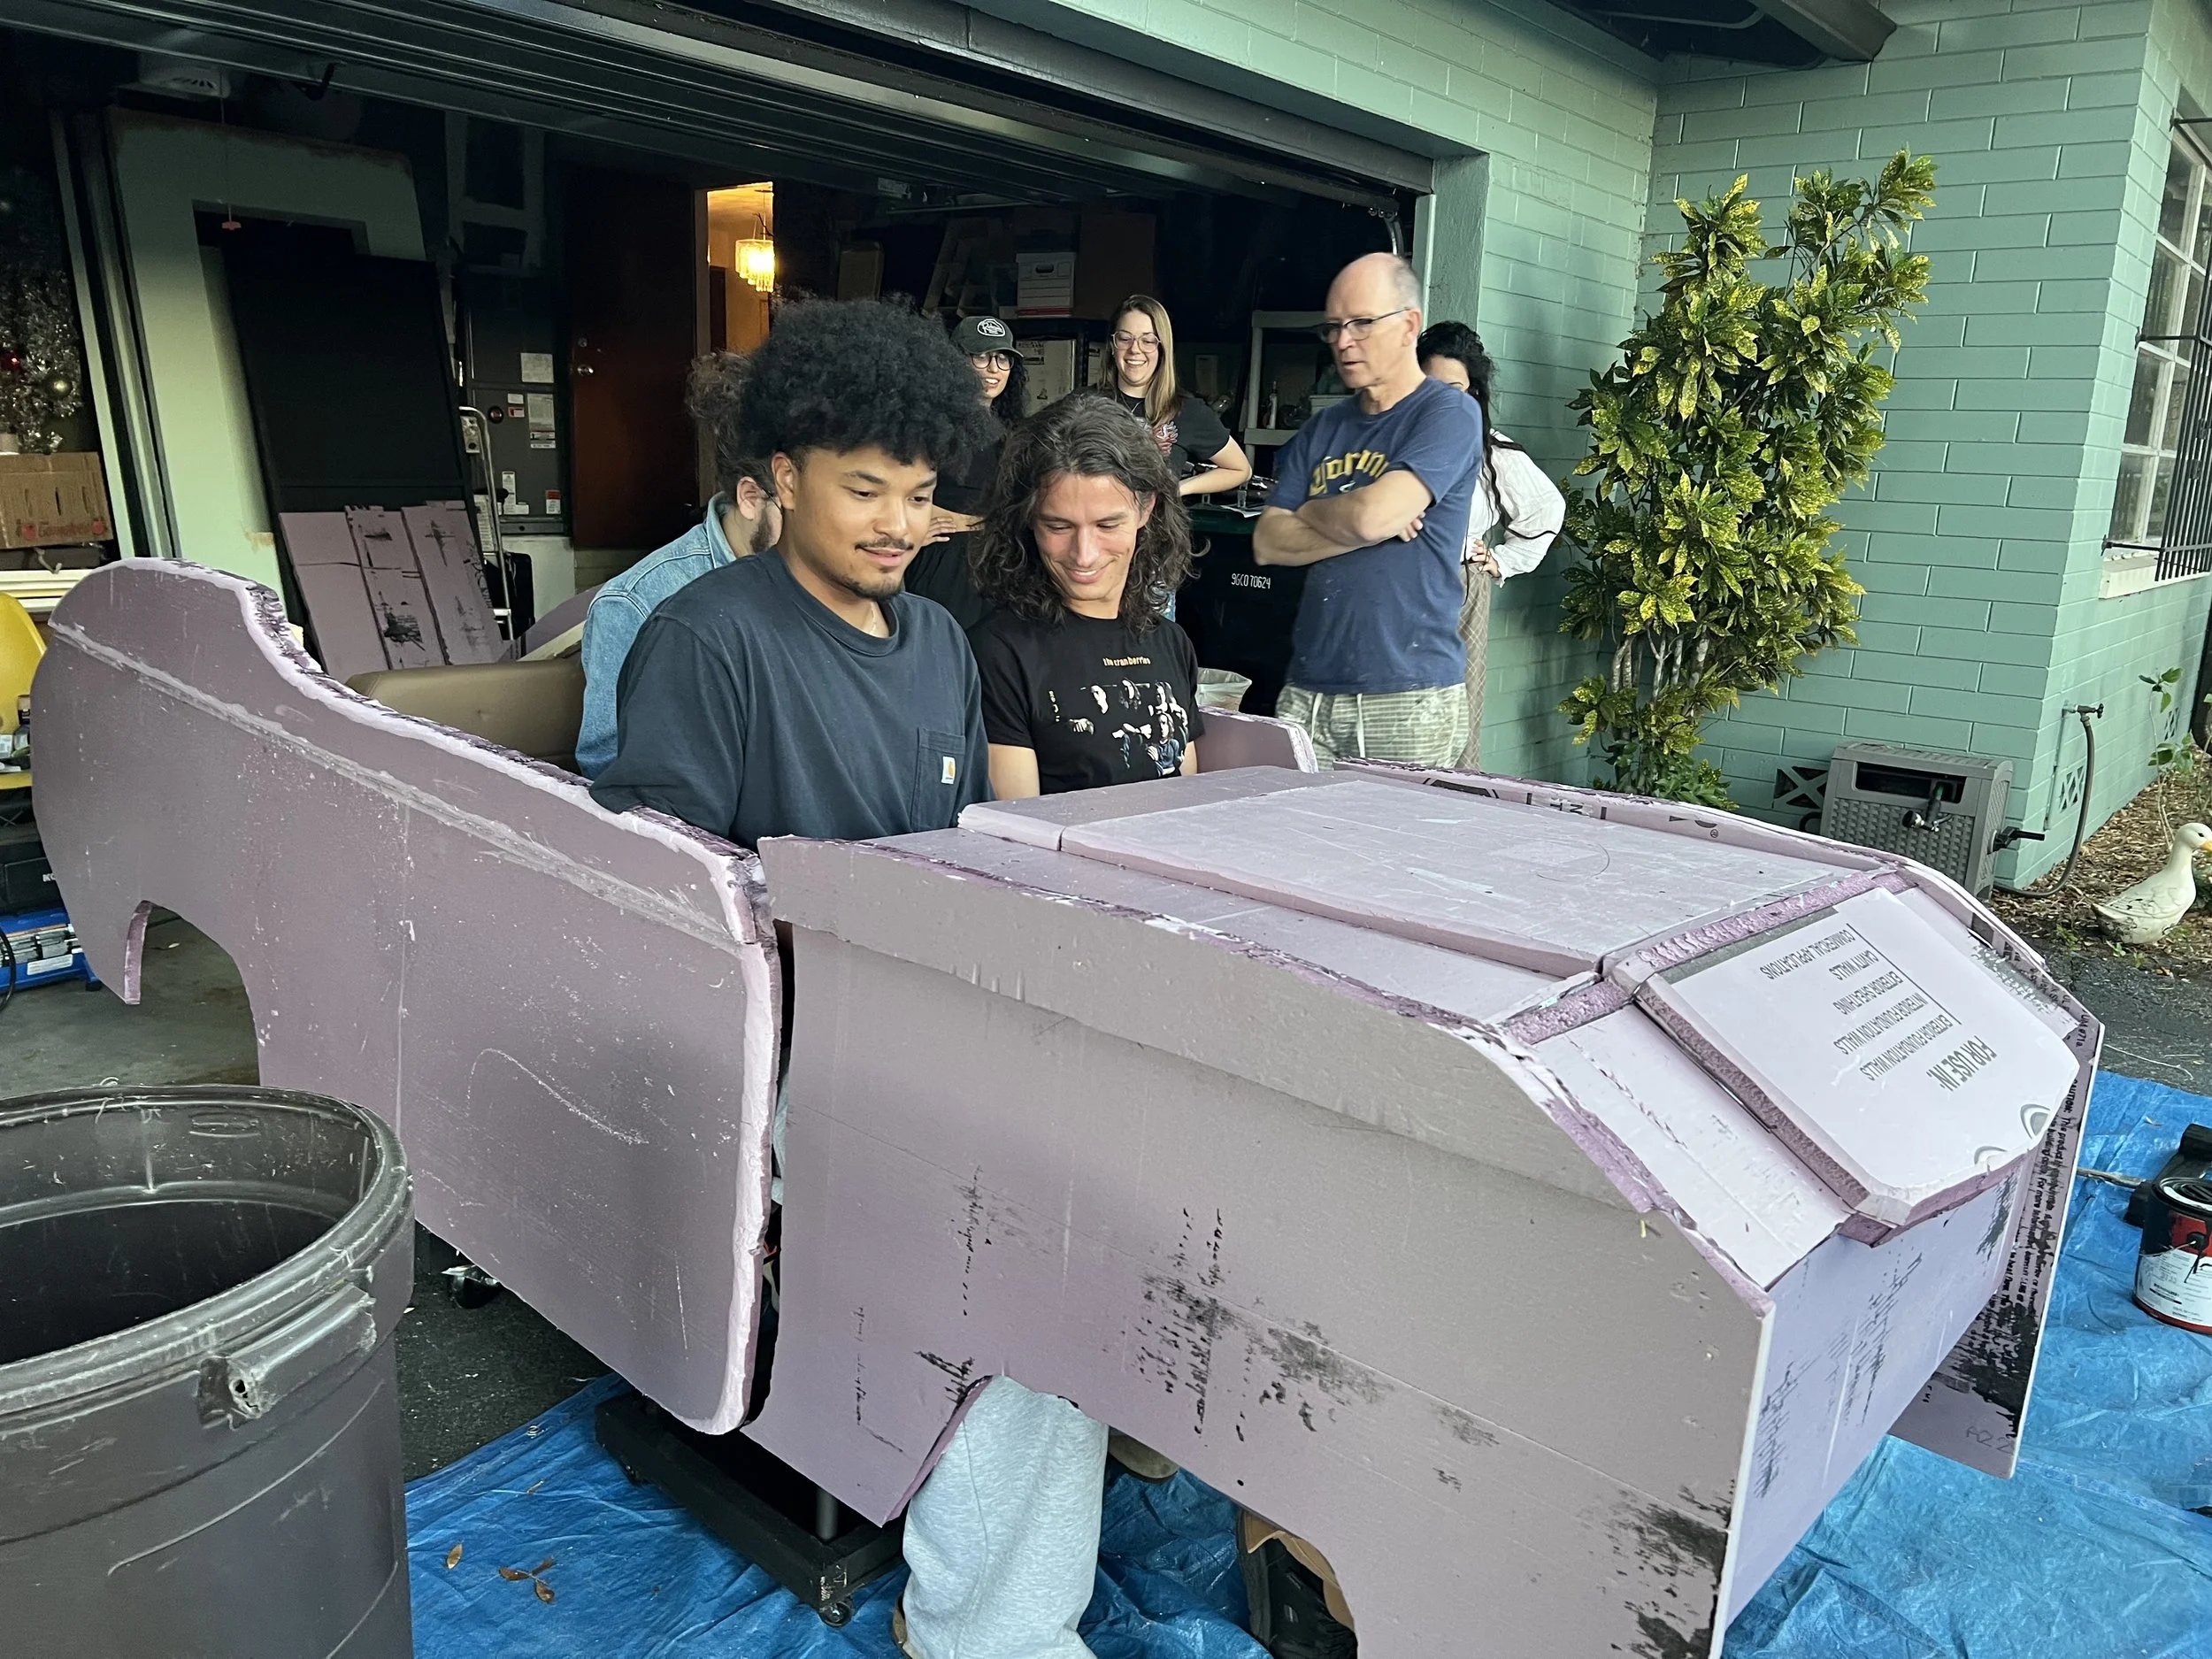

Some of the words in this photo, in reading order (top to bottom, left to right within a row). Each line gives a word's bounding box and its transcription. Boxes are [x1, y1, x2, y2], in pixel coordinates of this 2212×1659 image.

[1808, 929, 1855, 956] COMMERCIAL
[1760, 947, 1816, 979] APPLICATIONS
[1829, 961, 1856, 980] WALLS
[1850, 949, 1879, 969] CAVITY
[1871, 971, 1903, 995] EXTERIOR
[1832, 986, 1877, 1015] SHEATHING
[1897, 992, 1928, 1017] INTERIOR
[1856, 1007, 1902, 1041] FOUNDATION
[1921, 1014, 1953, 1040] EXTERIOR
[1833, 1031, 1864, 1055] WALLS
[1883, 1031, 1928, 1063] FOUNDATION
[1960, 1035, 1997, 1066] FOR
[1860, 1056, 1891, 1080] WALLS
[1925, 1064, 1960, 1091] IN:
[1940, 1050, 1978, 1082] USE
